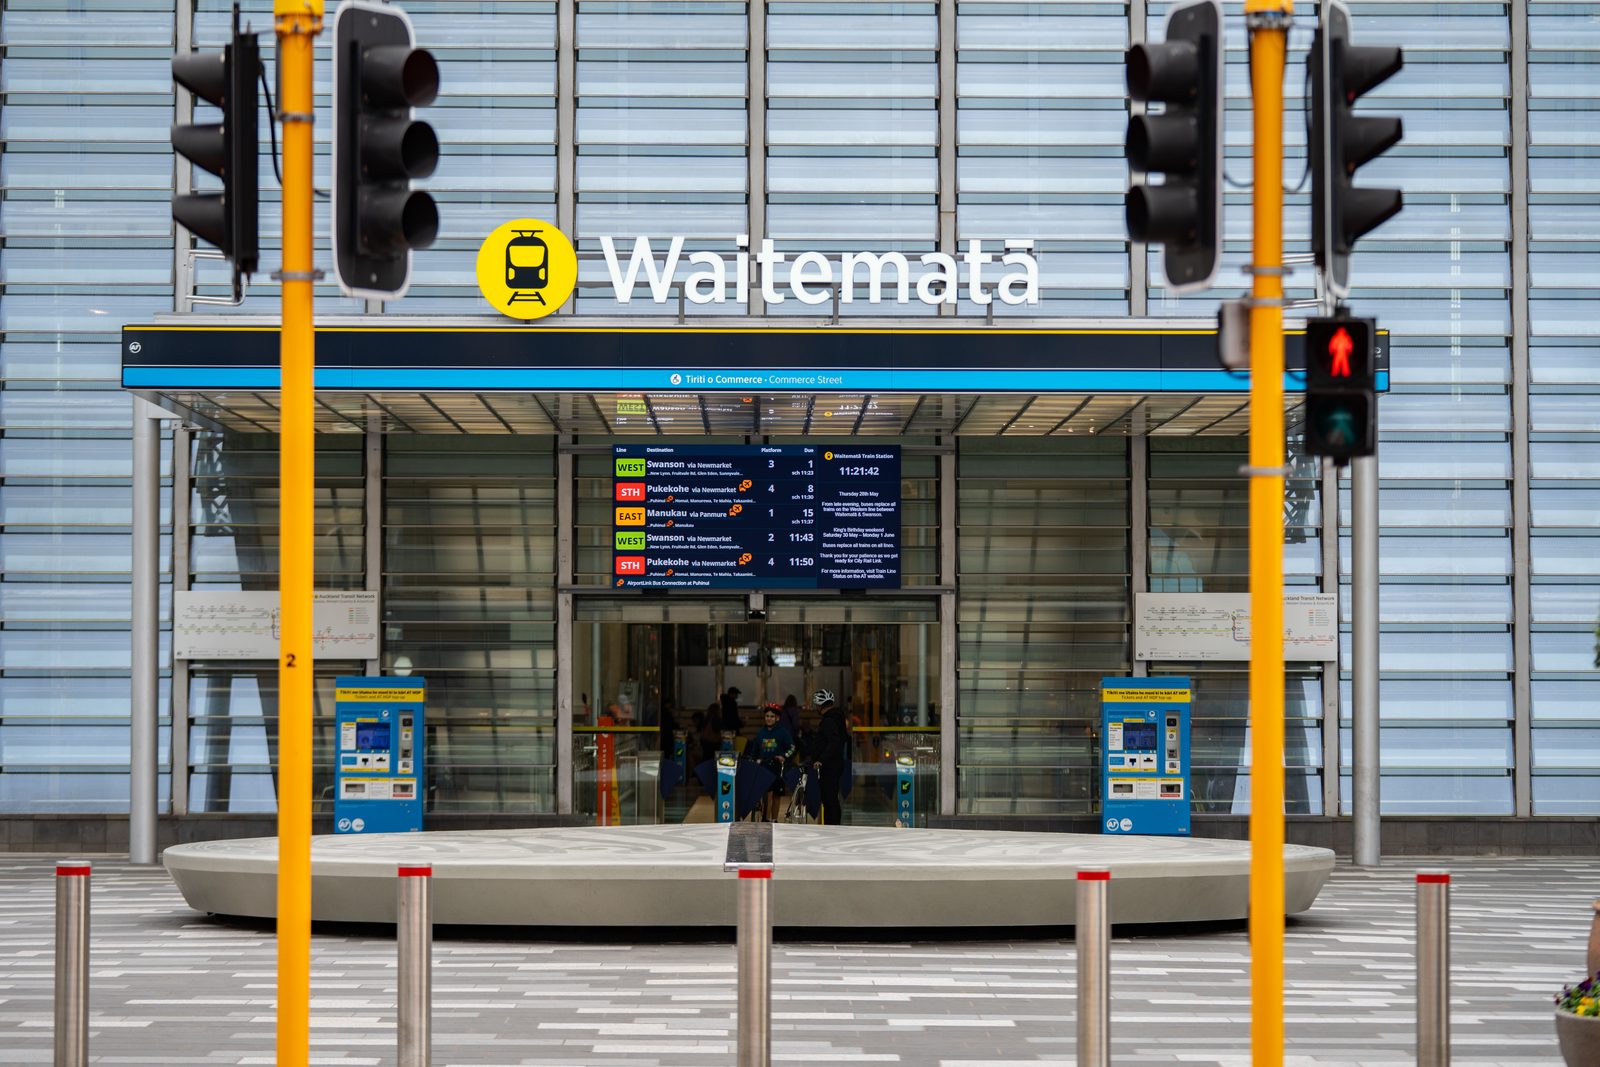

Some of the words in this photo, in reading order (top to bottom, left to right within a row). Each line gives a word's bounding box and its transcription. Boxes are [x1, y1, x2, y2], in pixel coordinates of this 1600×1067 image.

[600, 235, 1040, 305] Waitematā
[685, 375, 705, 383] Tiriti
[715, 375, 763, 384] Commerce
[769, 375, 815, 384] Commerce
[817, 376, 842, 384] Street
[768, 460, 775, 468] 3
[808, 460, 813, 468] 1
[839, 467, 879, 475] 11:21:42
[621, 488, 640, 496] STH
[768, 484, 775, 492] 4
[647, 509, 687, 517] Manukau
[768, 509, 774, 517] 1
[803, 509, 814, 517] 15
[768, 533, 774, 541] 2
[789, 533, 814, 541] 11:43
[621, 562, 640, 570] STH
[647, 558, 689, 566] Pukekohe
[768, 558, 775, 566] 4
[789, 558, 814, 566] 11:50
[286, 653, 296, 667] 2
